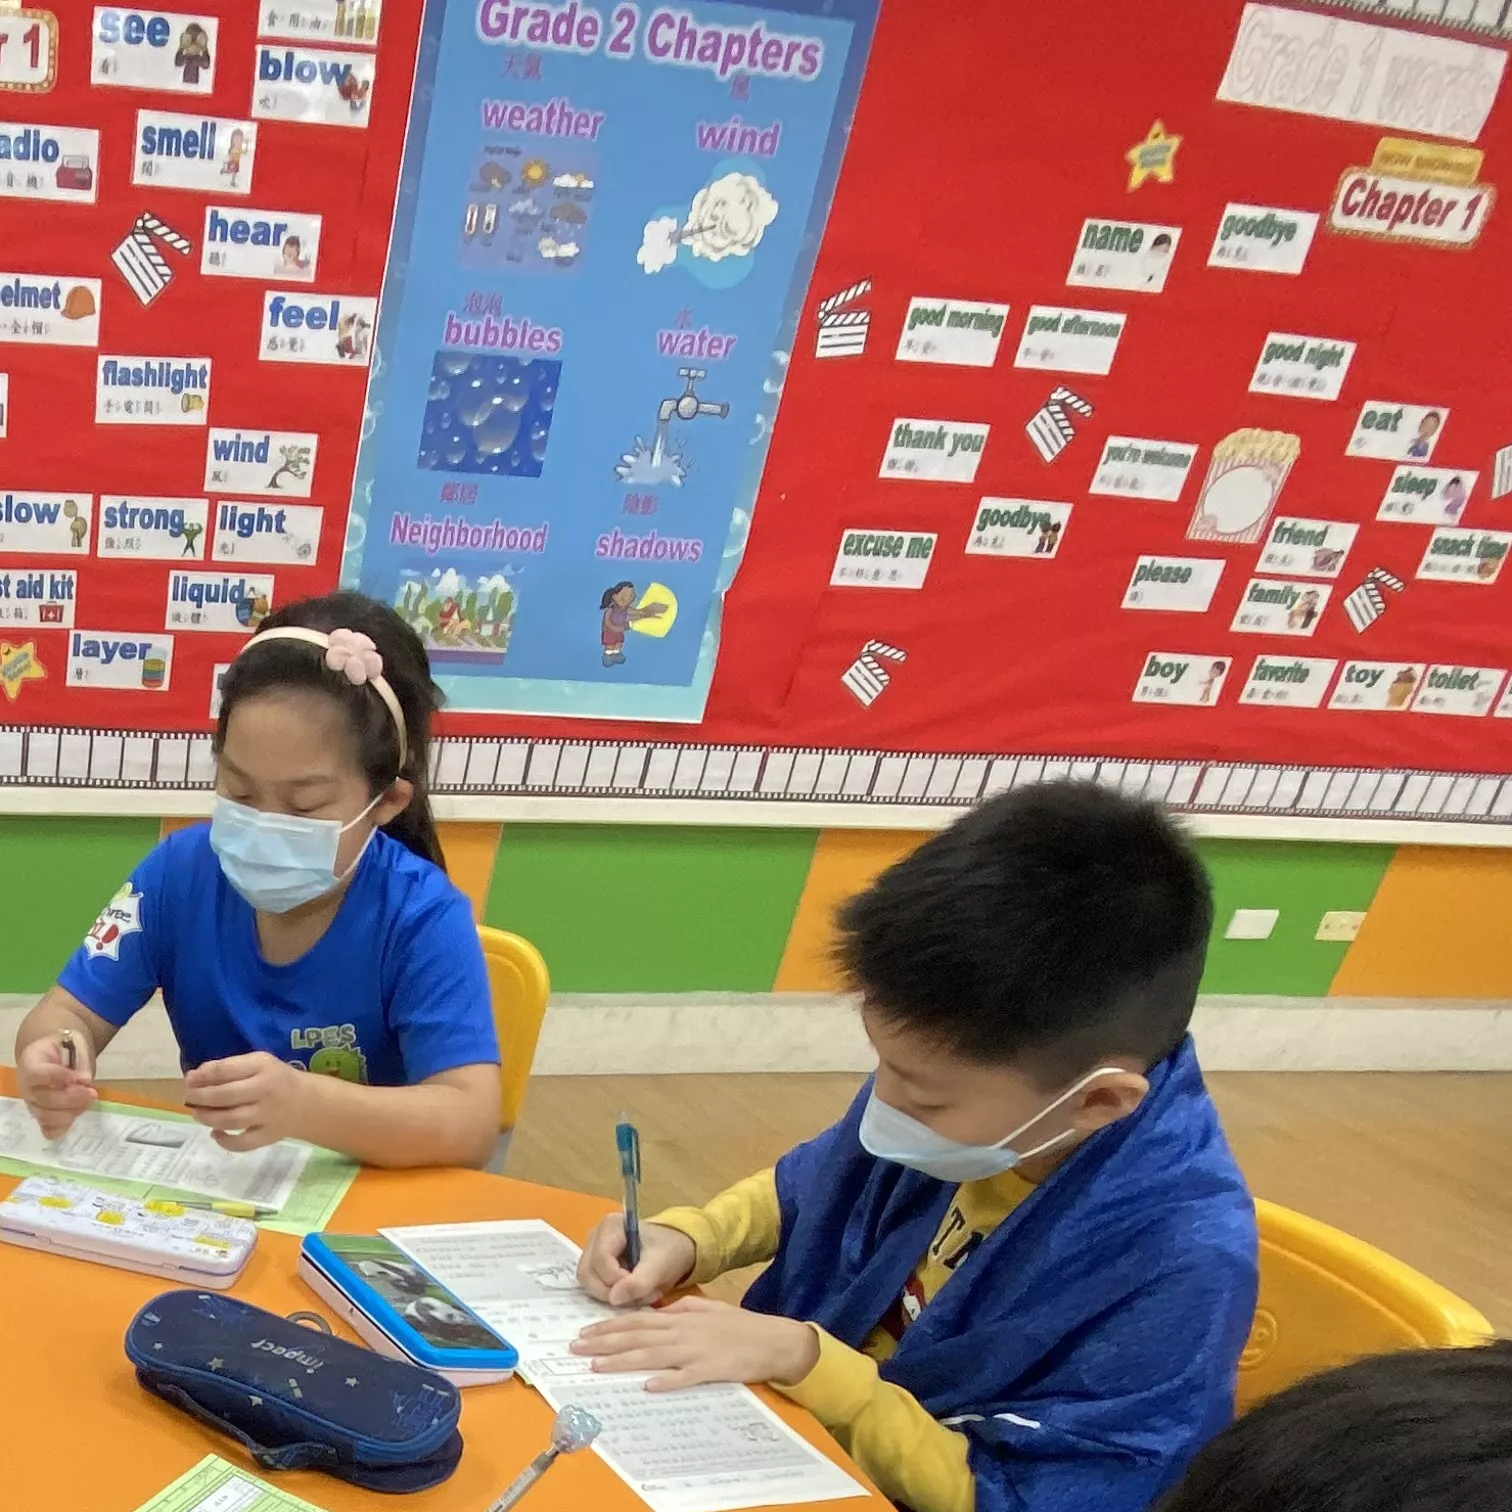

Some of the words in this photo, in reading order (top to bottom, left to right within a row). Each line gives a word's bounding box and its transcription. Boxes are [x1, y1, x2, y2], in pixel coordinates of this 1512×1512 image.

[98, 9, 171, 48] see
[479, 0, 599, 48] Grade
[608, 9, 637, 54] 2
[647, 13, 820, 76] Chapters
[21, 22, 42, 69] 1
[259, 49, 353, 87] blow
[482, 99, 604, 140] weather
[141, 120, 218, 160] smell
[698, 117, 780, 156] wind
[1341, 177, 1459, 231] Chapter
[1461, 193, 1484, 232] 1
[208, 209, 288, 247] hear
[1082, 224, 1144, 253] name
[1220, 211, 1298, 248] goodbye
[268, 296, 340, 331] feel
[907, 304, 948, 330] good
[946, 308, 1005, 338] morning
[1027, 312, 1063, 336] good
[444, 314, 562, 351] bubbles
[656, 328, 737, 359] water
[1262, 340, 1308, 366] good
[1304, 342, 1346, 371] night
[102, 360, 209, 395] flashlight
[1360, 407, 1404, 433] eat
[213, 433, 271, 464] wind
[894, 423, 948, 450] thank
[947, 431, 984, 457] you
[1391, 471, 1438, 502] sleep
[104, 500, 185, 538] strong
[219, 505, 287, 538] light
[390, 513, 548, 556] Neighborhood
[976, 504, 1051, 536] goodbye
[1271, 520, 1330, 547] friend
[595, 527, 704, 562] shadows
[843, 533, 904, 558] excuse
[905, 535, 934, 560] me
[1430, 534, 1476, 557] snack
[16, 573, 44, 599] aid
[49, 574, 74, 600] kit
[1132, 559, 1193, 586] please
[171, 575, 246, 608] liquid
[1246, 583, 1302, 610] family
[72, 633, 153, 664] layer
[1144, 656, 1189, 684] boy
[1251, 658, 1311, 684] favorite
[1344, 664, 1386, 688] toy
[1427, 667, 1481, 691] toilet
[290, 1023, 356, 1050] LPES
